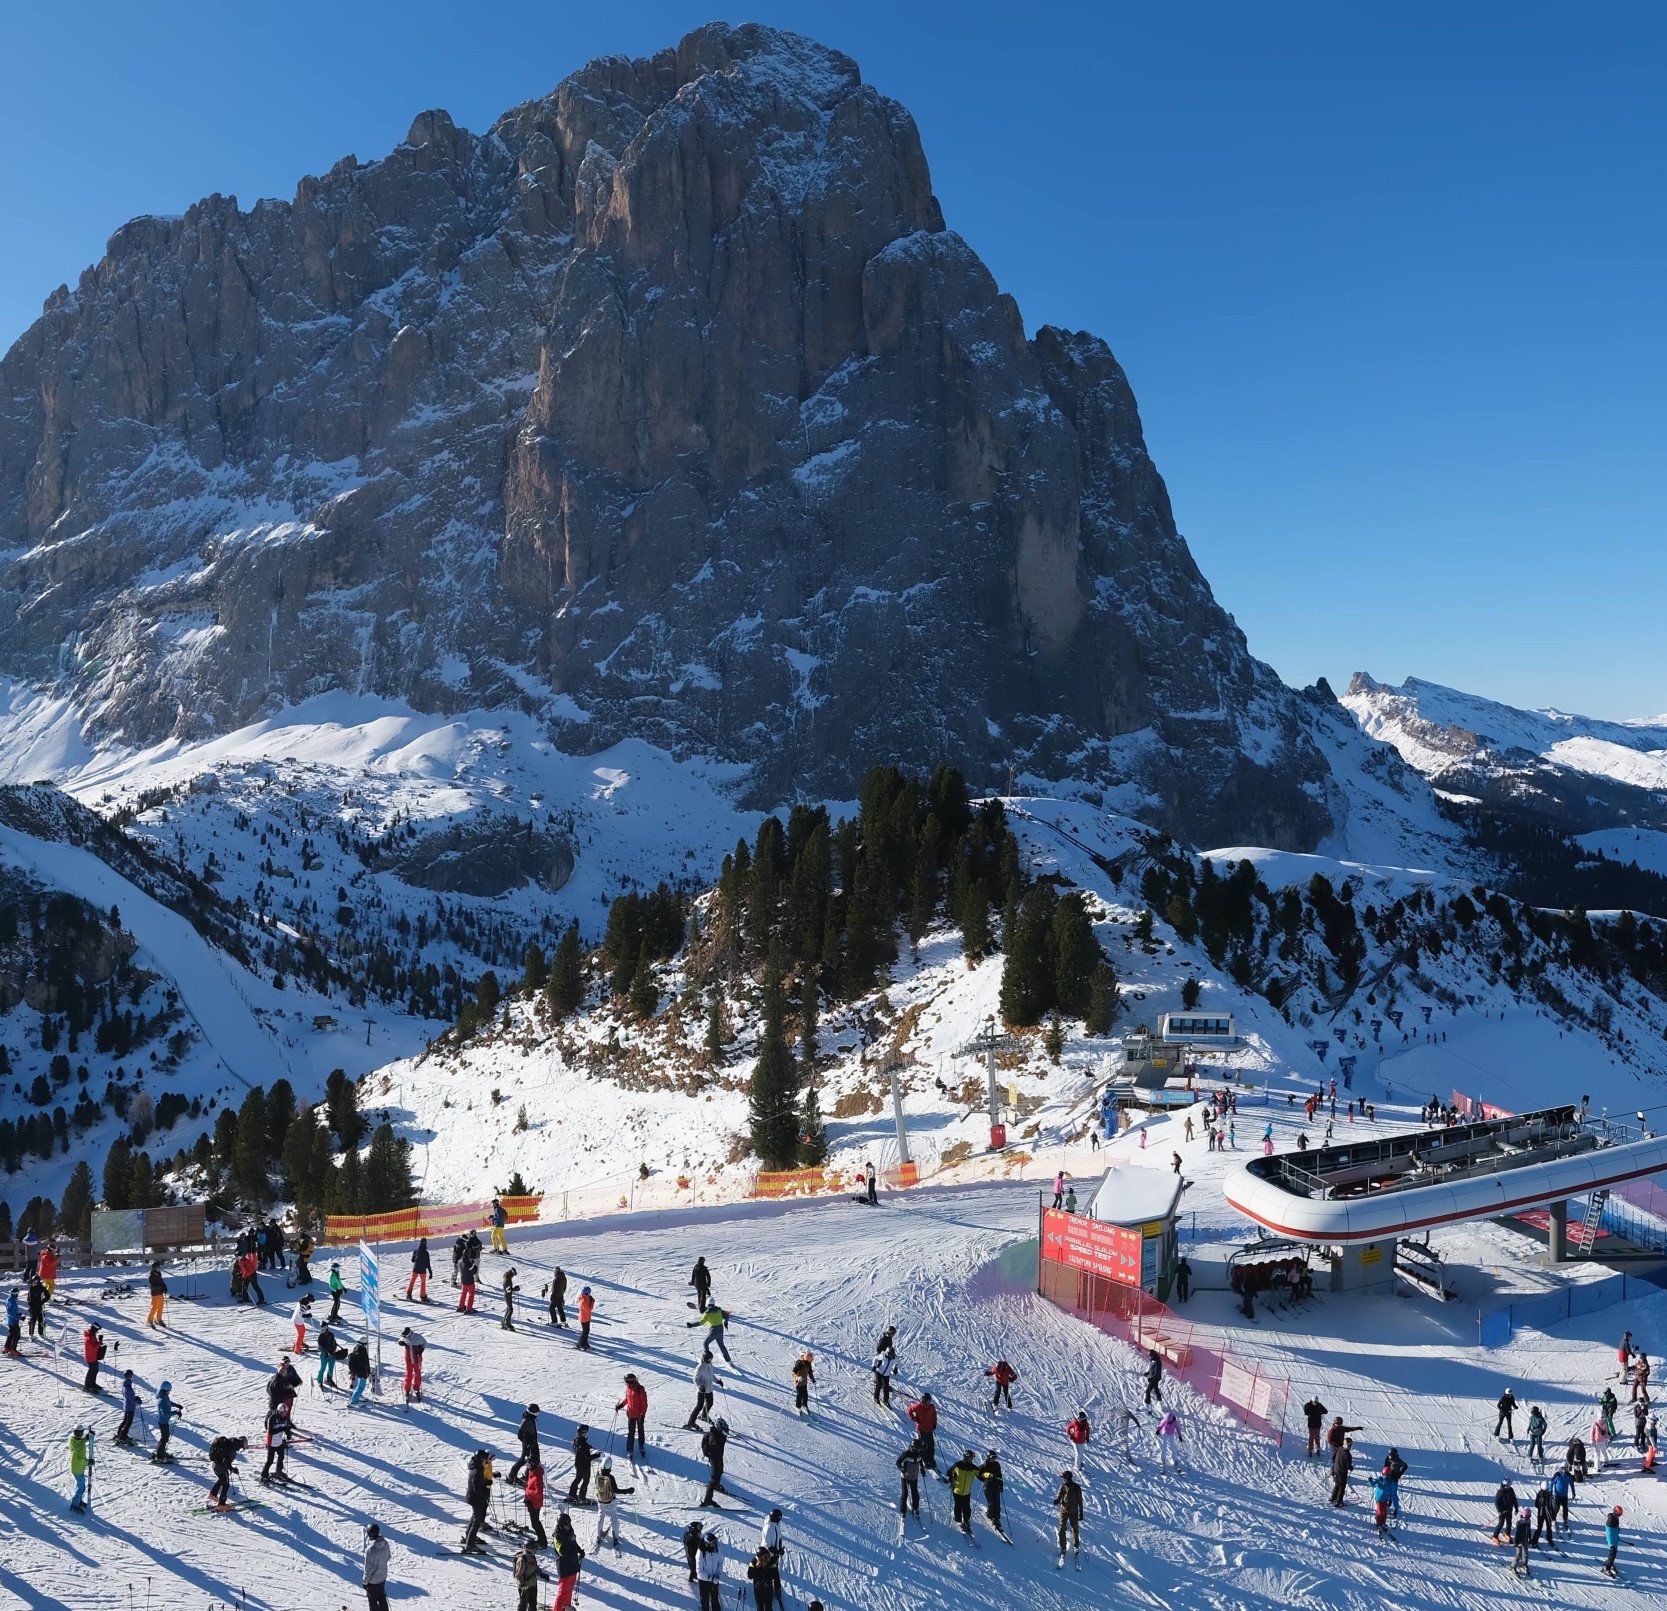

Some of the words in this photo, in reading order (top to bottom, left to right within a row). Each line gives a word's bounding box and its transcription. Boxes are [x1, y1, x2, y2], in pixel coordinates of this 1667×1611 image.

[1064, 1235, 1093, 1249] PARALLEL
[1069, 1244, 1093, 1256] SPEED
[1094, 1251, 1112, 1262] TEST
